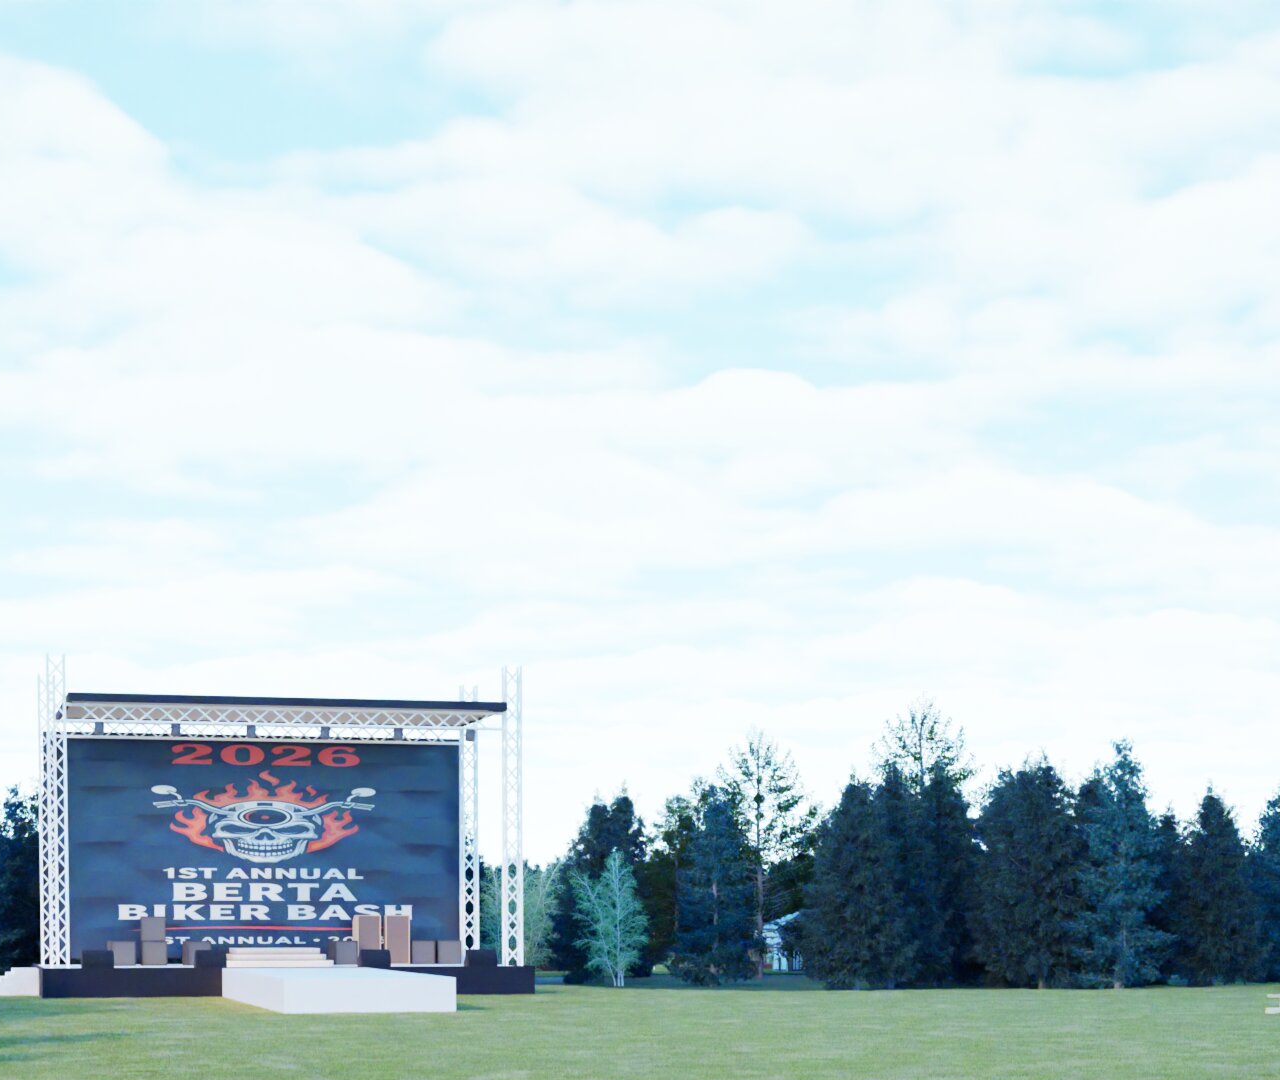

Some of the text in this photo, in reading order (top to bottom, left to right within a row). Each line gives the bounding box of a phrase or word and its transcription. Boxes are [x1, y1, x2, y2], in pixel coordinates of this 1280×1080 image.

[171, 743, 360, 767] 2026
[162, 867, 364, 880] 1ST ANNUAL
[171, 882, 358, 902] BERTA
[117, 903, 413, 921] BIKER BASH
[165, 936, 190, 945] ST
